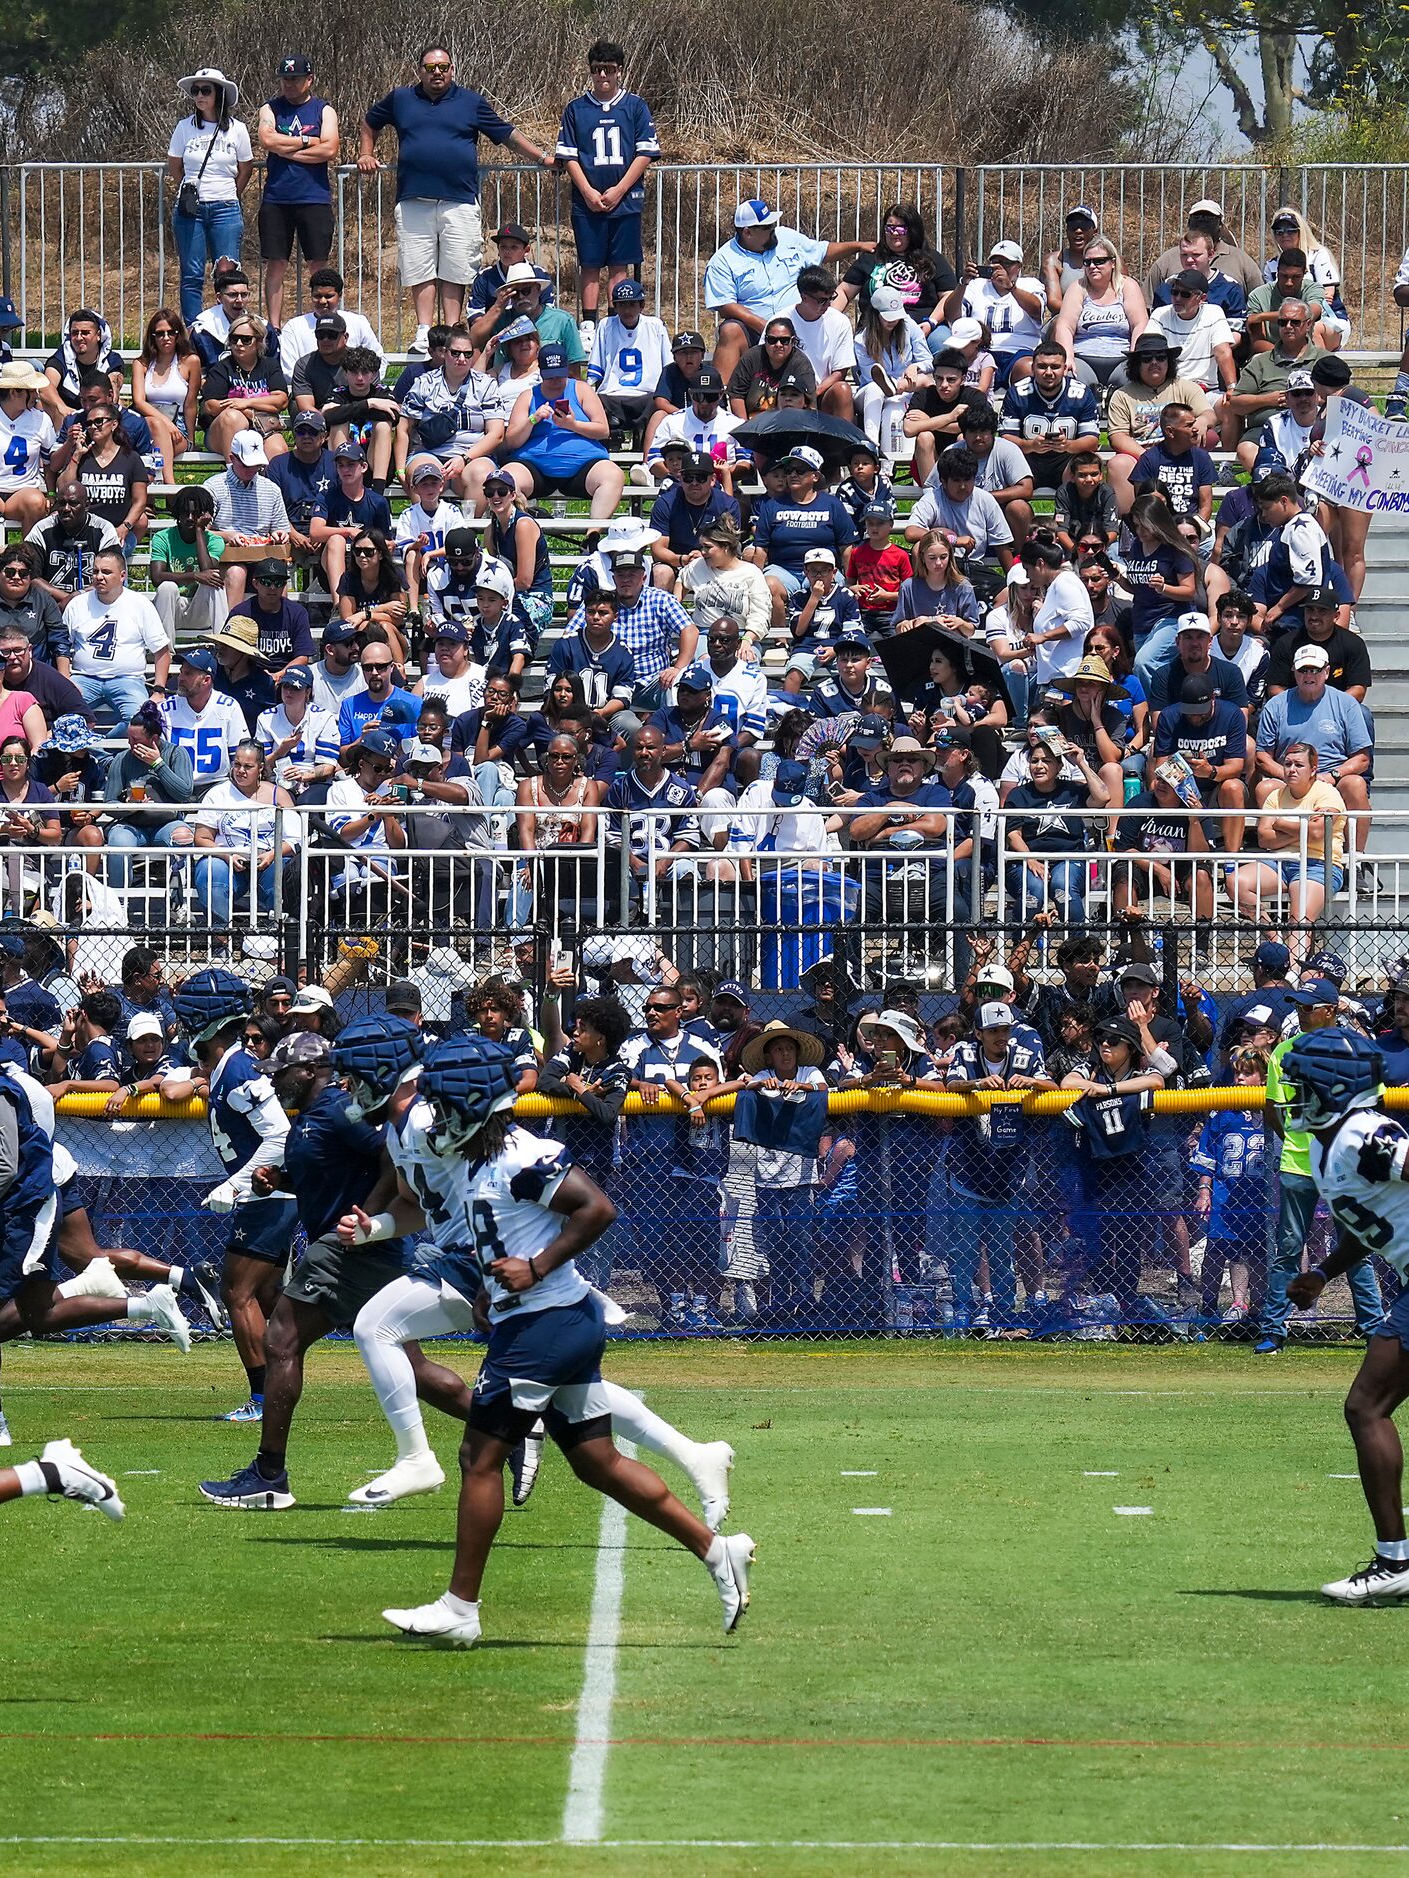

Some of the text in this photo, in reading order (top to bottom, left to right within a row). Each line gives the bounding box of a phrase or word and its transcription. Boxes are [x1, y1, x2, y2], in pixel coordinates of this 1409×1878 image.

[592, 126, 624, 166] 11
[984, 306, 1013, 333] 11
[619, 347, 642, 387] 9
[1339, 399, 1409, 439] MY BUCKET LI
[3, 435, 29, 475] 4
[81, 473, 124, 486] DALLAS
[1158, 471, 1194, 483] BEST
[1159, 465, 1194, 475] ONLY THE
[1348, 487, 1367, 507] MY
[775, 510, 830, 522] COWBOYS
[1305, 559, 1317, 577] 4
[1312, 589, 1321, 600] B
[813, 608, 835, 639] 7
[86, 620, 119, 661] 4
[579, 667, 608, 708] 11
[354, 711, 379, 721] Happy
[170, 727, 222, 774] 55
[1178, 736, 1227, 751] COWBOYS
[630, 814, 671, 855] 33
[993, 1106, 1003, 1114] My
[1095, 1097, 1123, 1111] PARSONS
[1102, 1107, 1126, 1135] 11
